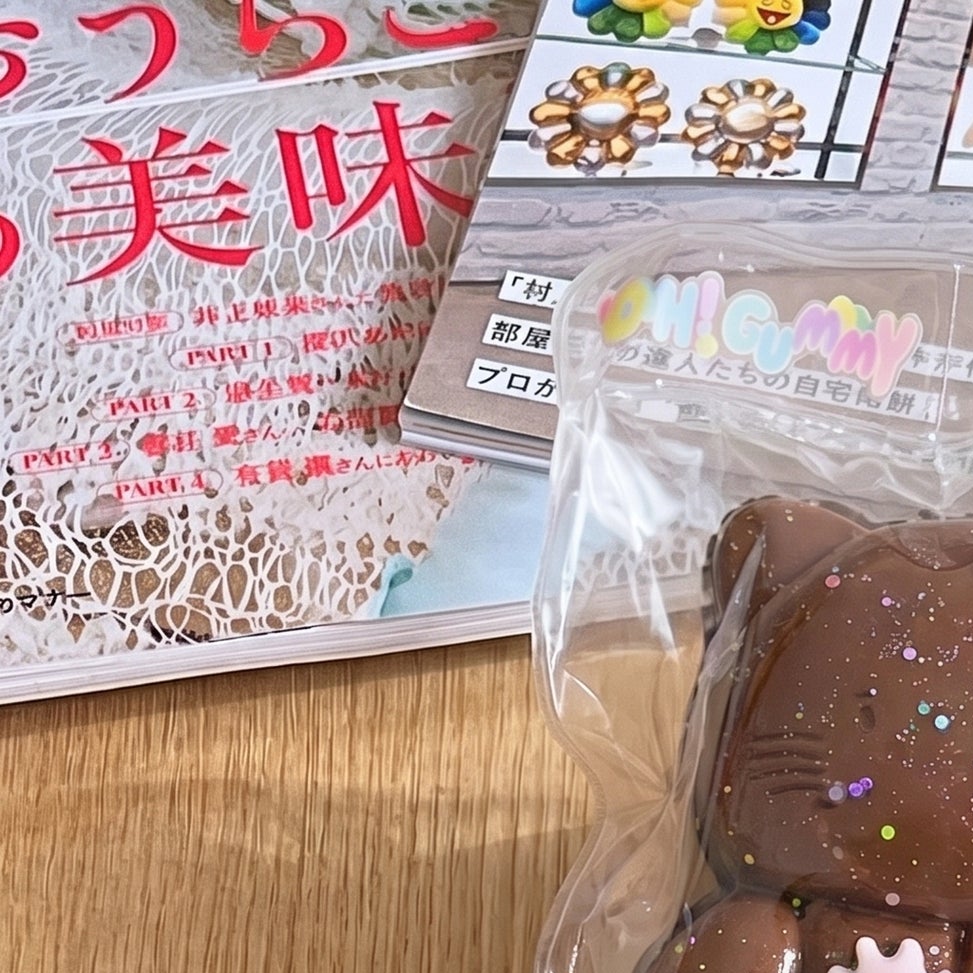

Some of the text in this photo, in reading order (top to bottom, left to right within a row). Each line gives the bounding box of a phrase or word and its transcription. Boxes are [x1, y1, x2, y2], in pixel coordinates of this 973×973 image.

[110, 396, 172, 416] PART
[23, 447, 88, 469] PART
[115, 473, 205, 500] PART 4
